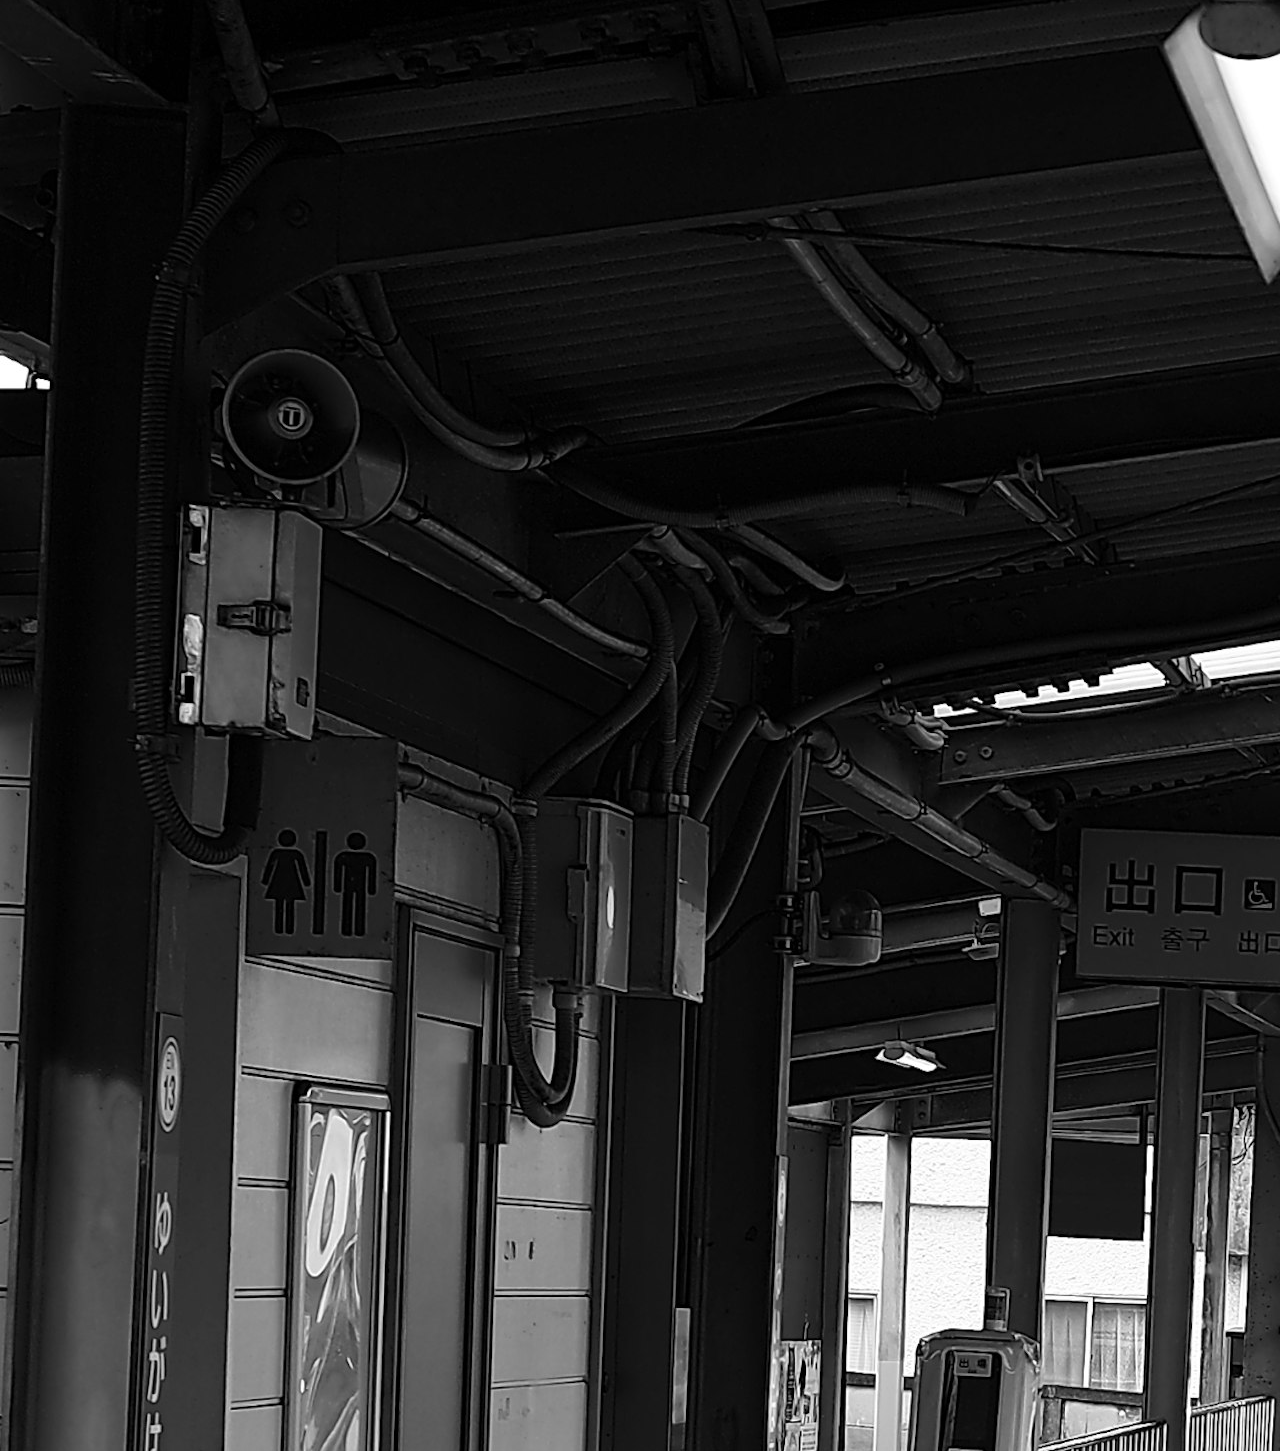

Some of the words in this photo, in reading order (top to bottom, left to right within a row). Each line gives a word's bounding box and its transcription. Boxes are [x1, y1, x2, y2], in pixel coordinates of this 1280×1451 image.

[1106, 858, 1224, 916] 出口
[1092, 925, 1135, 948] Exit
[1161, 927, 1210, 952] 출구
[164, 1075, 176, 1111] 13
